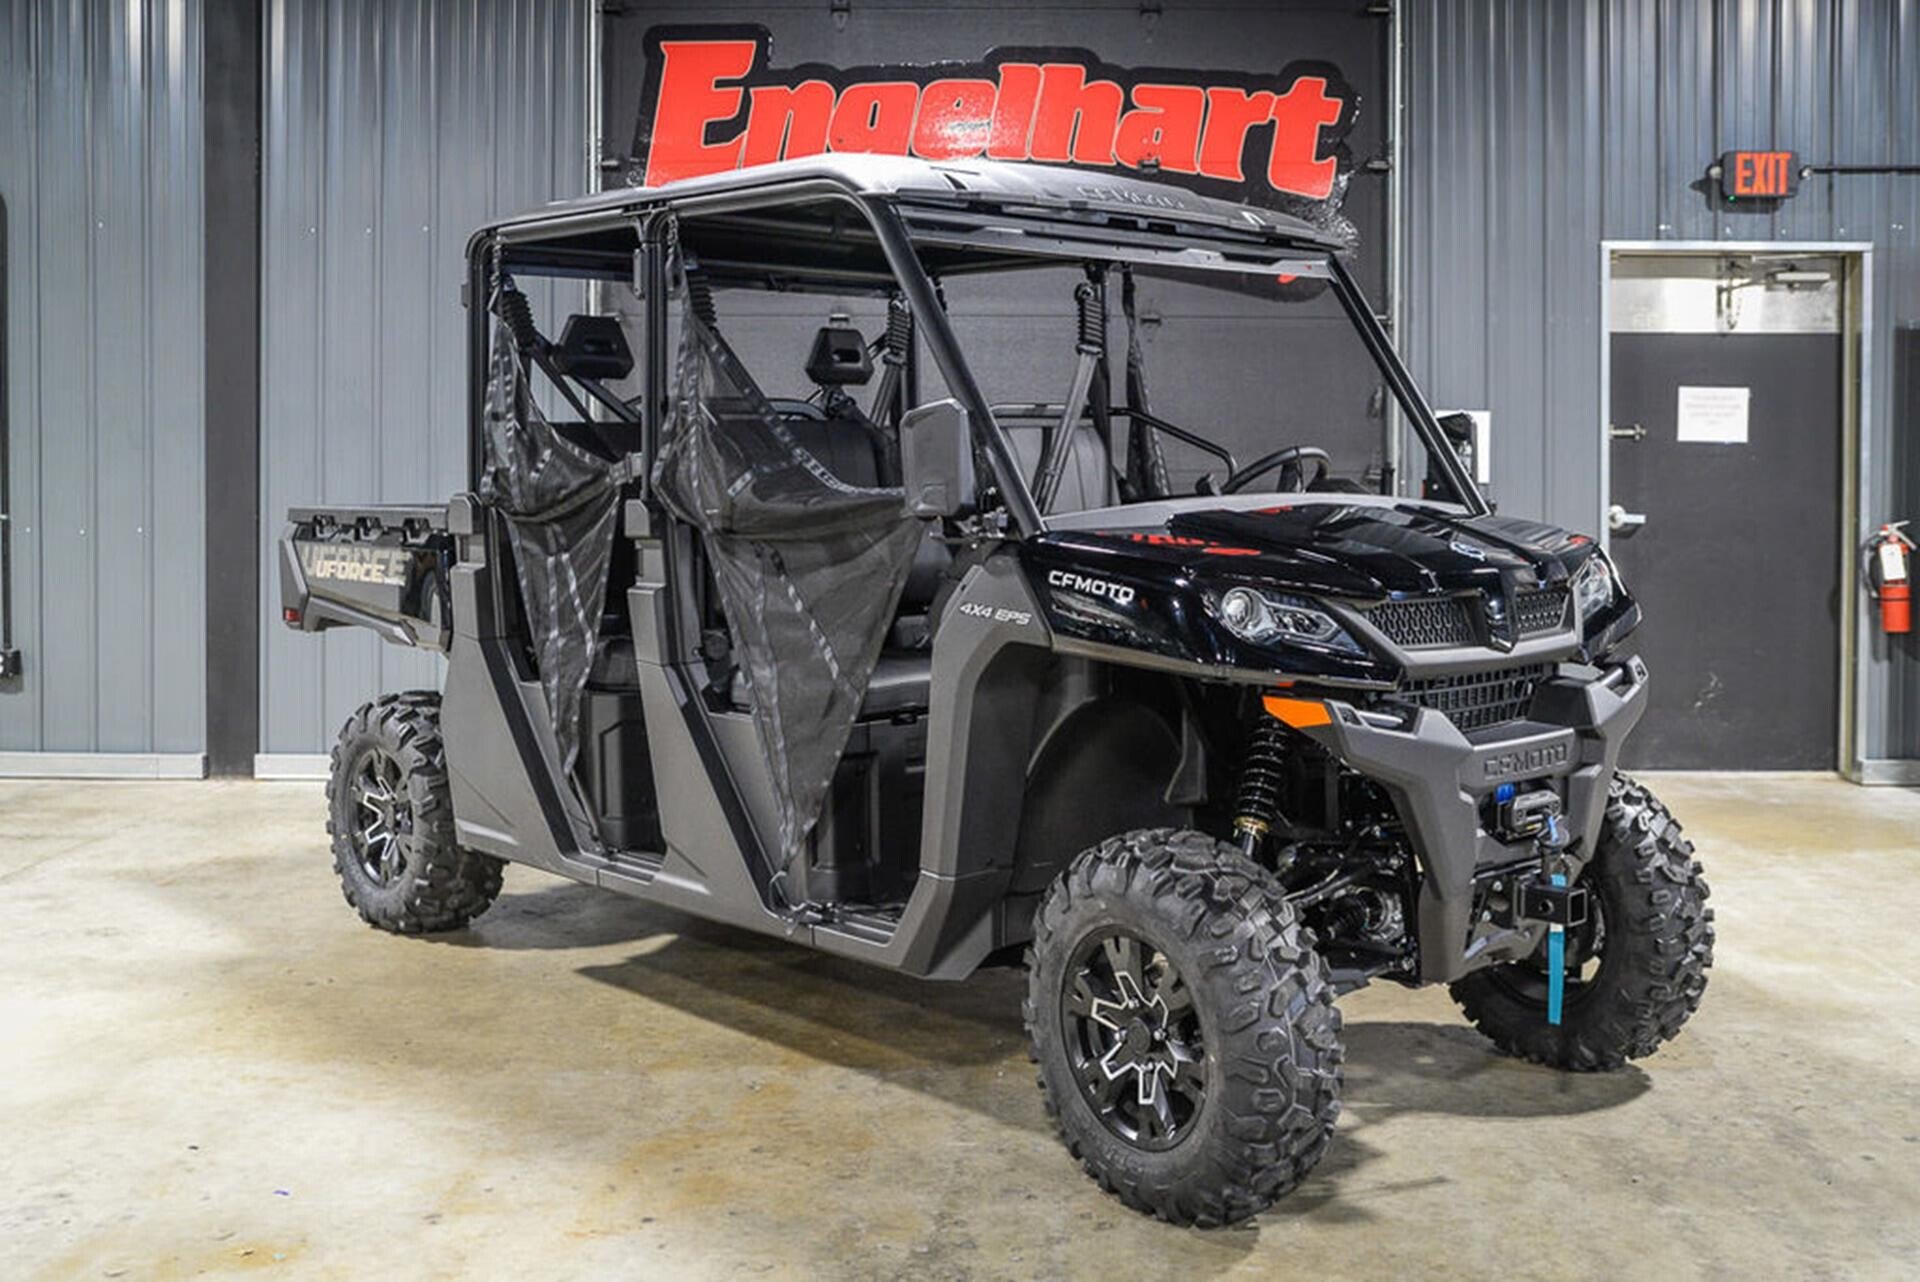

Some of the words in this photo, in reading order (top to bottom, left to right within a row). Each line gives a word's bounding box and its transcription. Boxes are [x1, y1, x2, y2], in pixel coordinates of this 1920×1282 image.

[644, 40, 1343, 198] Engelhart
[1735, 151, 1791, 195] EXIT
[316, 560, 386, 584] UFORCE
[1049, 570, 1135, 605] CFMOTO
[960, 602, 993, 618] 4X4
[995, 608, 1032, 625] EPS
